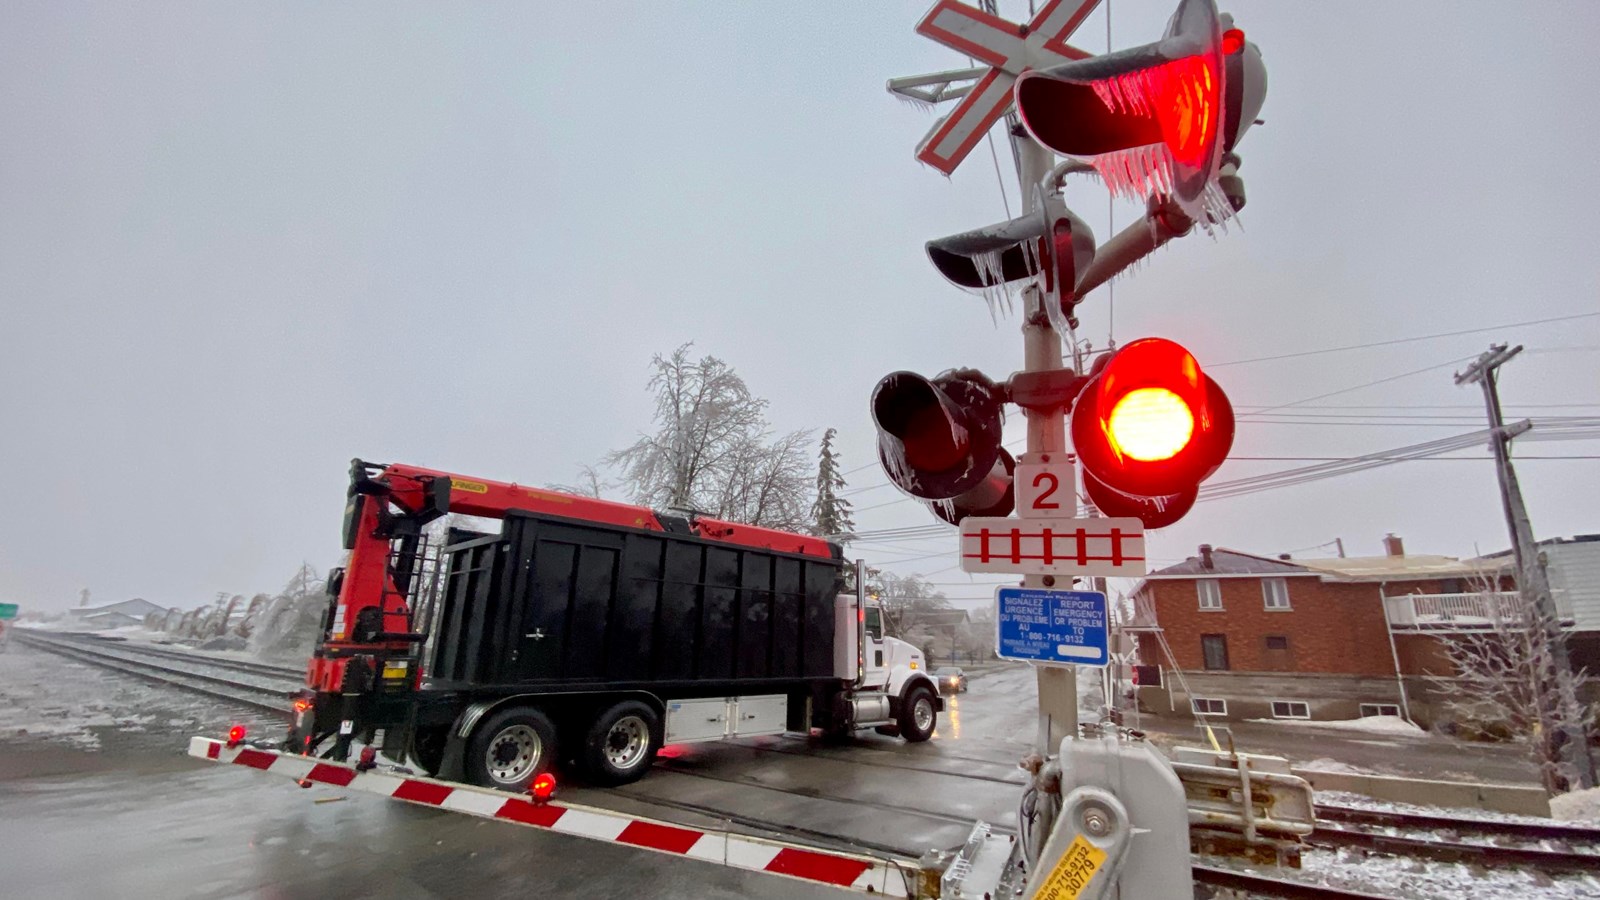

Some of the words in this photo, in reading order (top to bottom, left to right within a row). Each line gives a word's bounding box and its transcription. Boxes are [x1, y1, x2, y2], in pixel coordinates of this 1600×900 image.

[1032, 472, 1060, 510] 2
[1004, 597, 1044, 607] SIGNALEZ
[1060, 600, 1095, 609] REPORT
[1004, 605, 1043, 616] URGENCE
[1053, 608, 1103, 619] EMERGENCY
[1019, 623, 1030, 631] AU
[1054, 617, 1065, 625] OR
[1068, 618, 1102, 627] PROBLEM
[1072, 627, 1085, 635] TO
[1044, 846, 1090, 900] 00-716-9132
[1065, 859, 1096, 896] 30779
